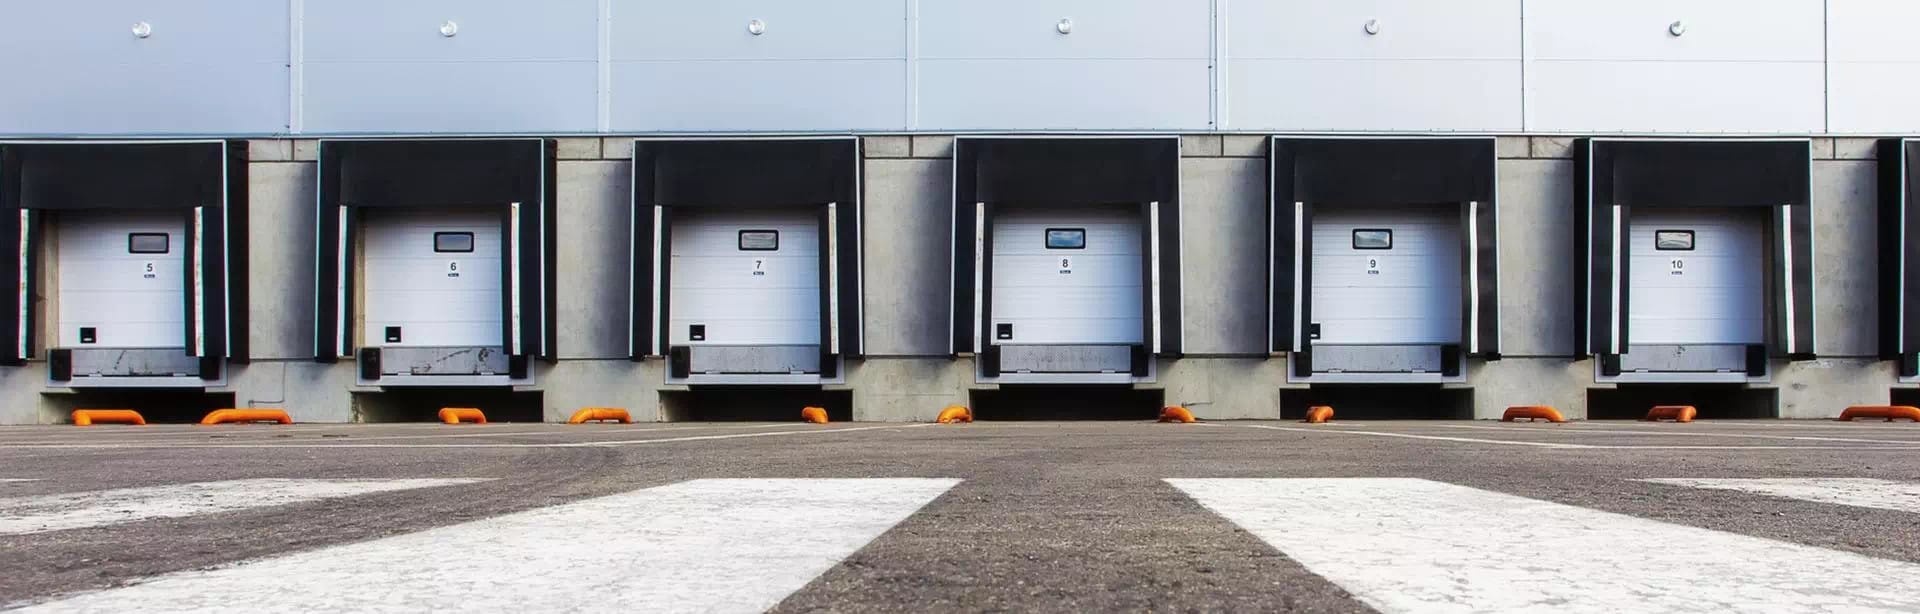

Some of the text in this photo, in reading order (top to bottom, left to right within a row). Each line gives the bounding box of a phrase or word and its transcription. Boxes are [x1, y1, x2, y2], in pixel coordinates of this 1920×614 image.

[146, 262, 153, 272] 5
[450, 261, 457, 271] 6
[755, 260, 762, 270] 7
[1062, 259, 1069, 269] 8
[1369, 259, 1377, 269] 9
[1671, 259, 1683, 269] 10
